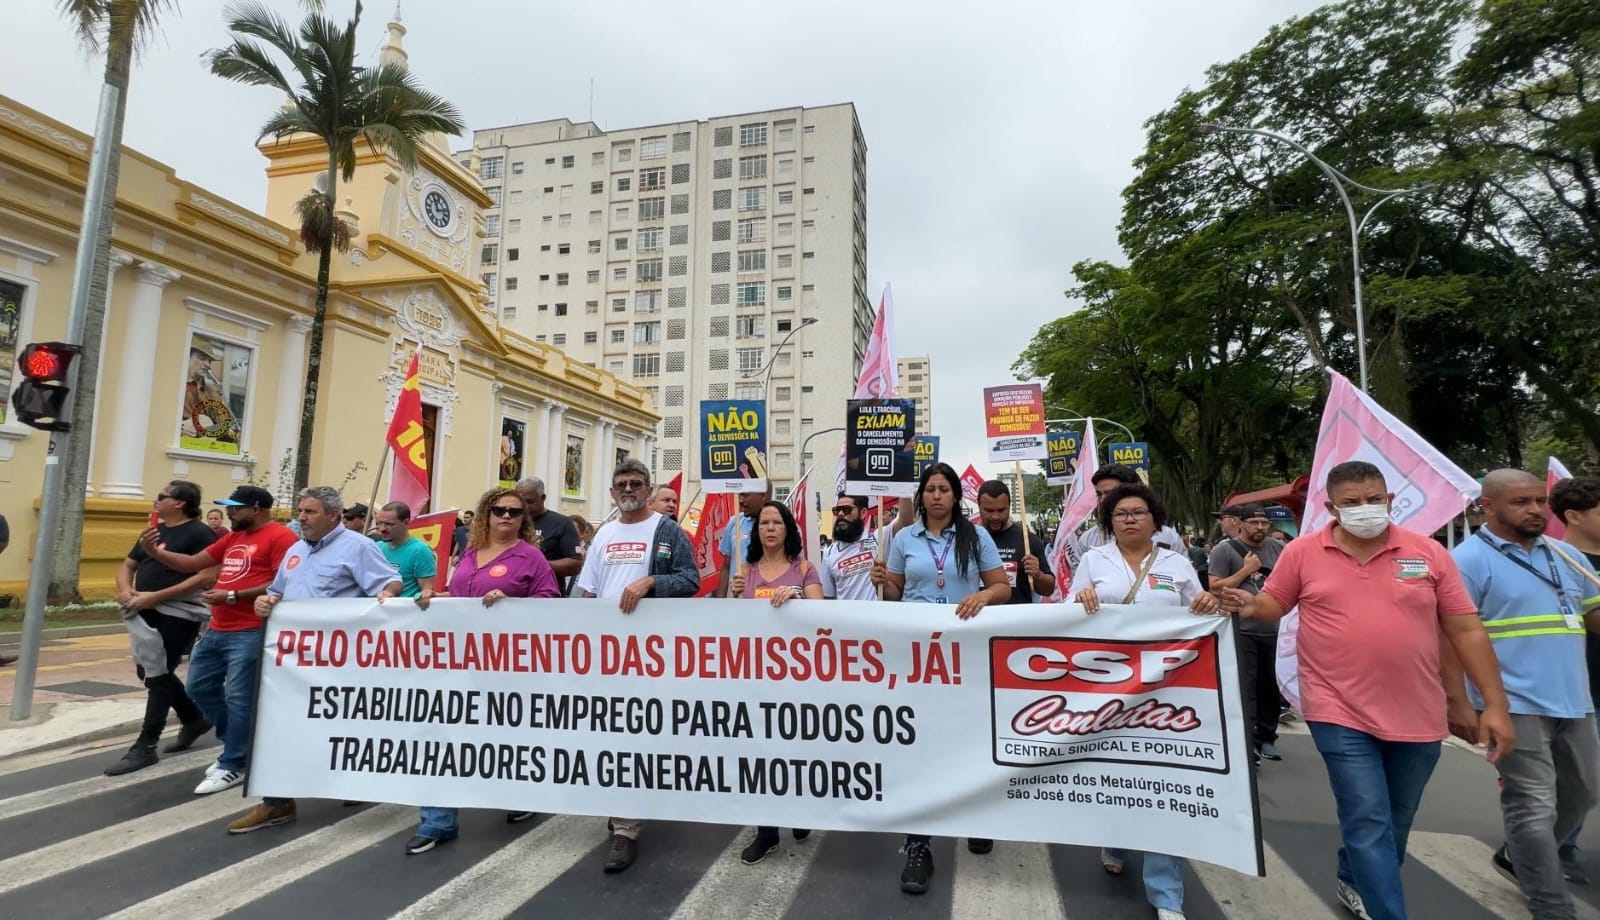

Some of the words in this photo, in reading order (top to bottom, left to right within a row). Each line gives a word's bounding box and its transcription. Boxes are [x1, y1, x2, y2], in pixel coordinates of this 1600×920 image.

[409, 350, 441, 367] CMARA
[708, 406, 759, 432] NÃO
[990, 415, 1014, 424] PROIBIDA
[1015, 415, 1022, 423] DE
[1024, 414, 1040, 422] FAZER
[999, 407, 1010, 416] TEM
[857, 414, 906, 429] EXIJAM
[718, 432, 749, 440] DEMISSÕES
[867, 438, 896, 446] DEMISSÕES
[915, 440, 934, 454] ÃO
[1048, 437, 1076, 452] NÃO
[714, 451, 732, 466] gm
[1114, 446, 1143, 460] NÃO
[871, 455, 889, 470] gm
[276, 629, 348, 668] PELO
[356, 629, 592, 675] CANCELAMENTO
[601, 634, 665, 677] DAS
[674, 628, 896, 690] DEMISSÕES,
[907, 632, 962, 685] JÁ!
[1006, 647, 1199, 685] CSP
[307, 685, 481, 725] ESTABILIDADE
[486, 690, 523, 728] NO
[530, 692, 663, 736] EMPREGO
[671, 699, 754, 739] PARA
[759, 702, 864, 743] TODOS
[873, 704, 916, 745] OS
[1011, 695, 1201, 736] Conlutas
[1004, 743, 1065, 758] CENTRAL
[1068, 740, 1130, 756] SINDICAL
[1132, 741, 1140, 753] E
[1144, 742, 1215, 760] POPULAR
[328, 736, 546, 783] TRABALHADORES
[553, 748, 590, 786] DA
[596, 749, 732, 794] GENERAL
[738, 755, 883, 802] MOTORS!
[1009, 774, 1069, 787] Sindicato
[1073, 773, 1097, 787] dos
[1101, 774, 1192, 796] Metalúrgicos
[1196, 784, 1215, 799] de
[1007, 788, 1030, 800] São
[1034, 788, 1064, 802] José
[1068, 790, 1092, 804] dos
[1096, 792, 1153, 810] Campos
[1157, 800, 1166, 810] e
[1170, 801, 1219, 819] Região
